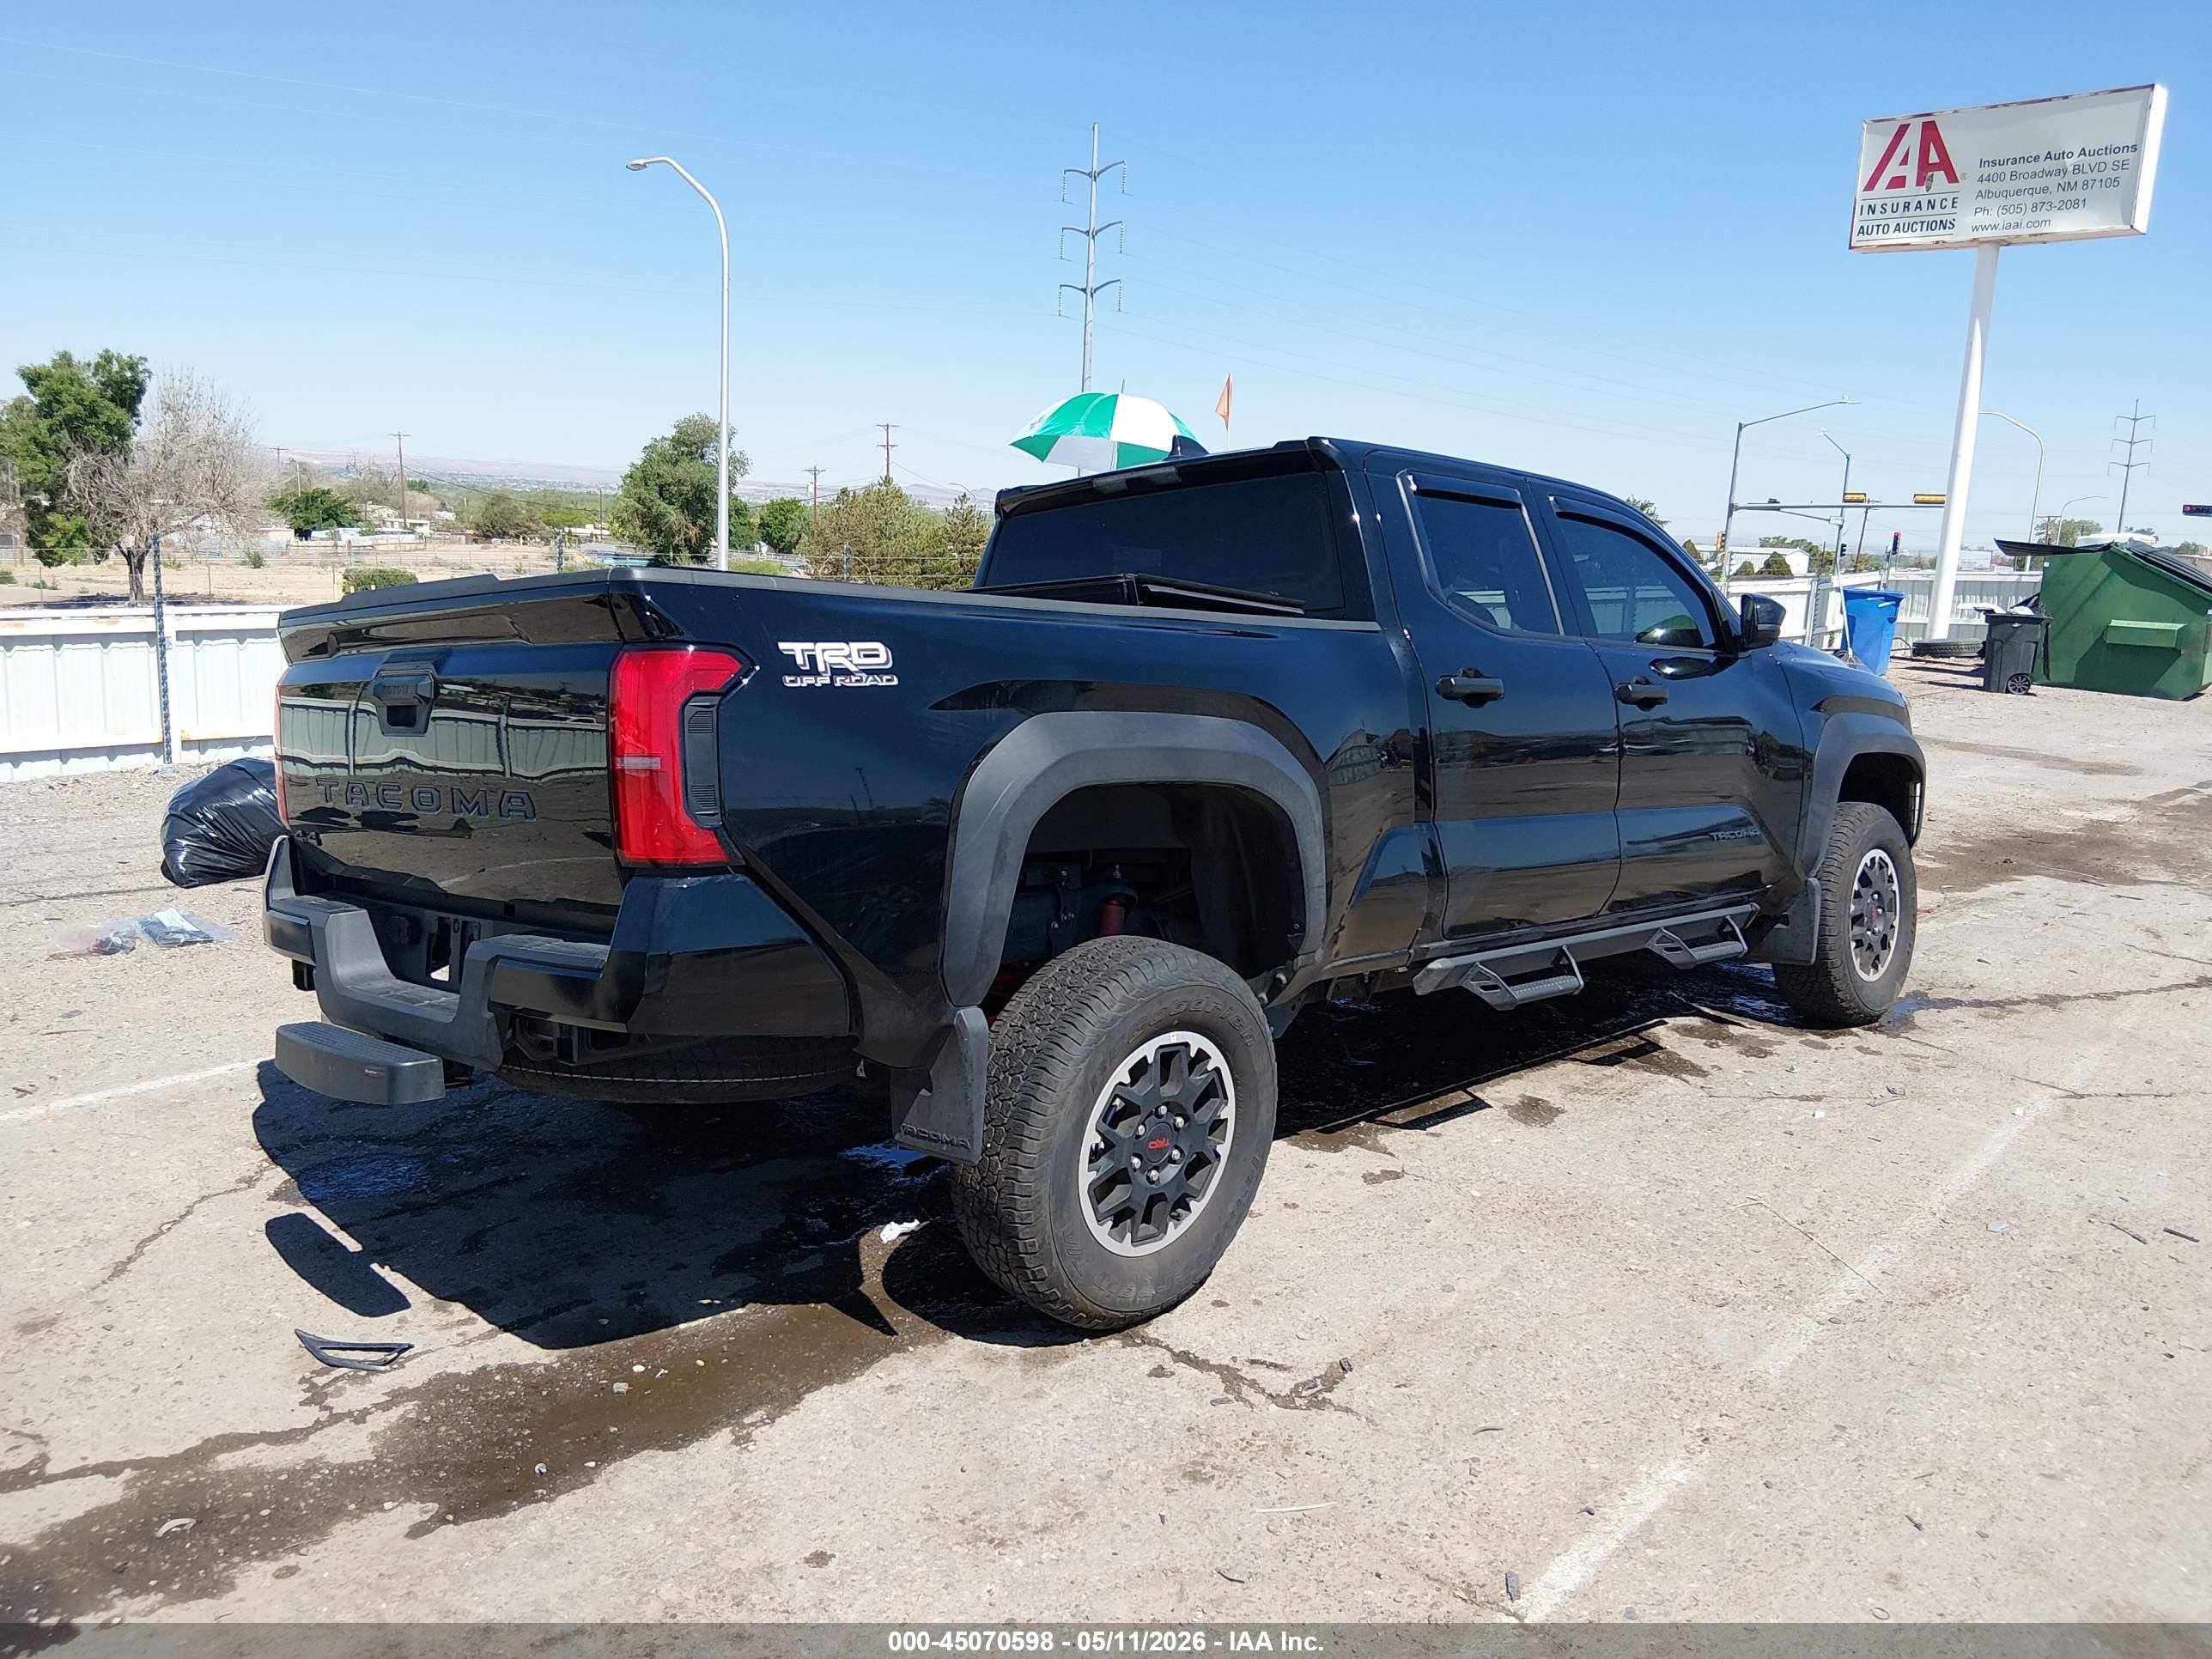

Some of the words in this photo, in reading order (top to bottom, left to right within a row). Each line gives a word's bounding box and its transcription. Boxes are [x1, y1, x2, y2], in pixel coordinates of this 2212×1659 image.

[1979, 153, 2040, 168] Insurance
[2043, 150, 2075, 162] Auto
[2076, 143, 2138, 159] Auctions
[1977, 172, 2007, 184] 4400
[2009, 166, 2069, 182] Broadway
[2072, 161, 2107, 175] BLVD
[2111, 159, 2130, 171] SE
[1975, 184, 2052, 200] Albuquerque,
[2057, 181, 2078, 193] NM
[2081, 176, 2120, 191] 87105
[1860, 197, 1959, 216] INSURANCE
[1973, 206, 1993, 217] Ph:
[1996, 204, 2027, 218] (505)
[2031, 198, 2087, 213] 873-2081
[1856, 223, 1890, 237] AUTO
[1893, 218, 1956, 234] AUCTIONS
[1972, 218, 2051, 232] www.iaai.com
[777, 641, 893, 676] TRD
[782, 674, 831, 687] OFF
[833, 674, 899, 687] ROAD
[315, 777, 537, 822] TACOMA
[1709, 829, 1759, 840] TACOMA
